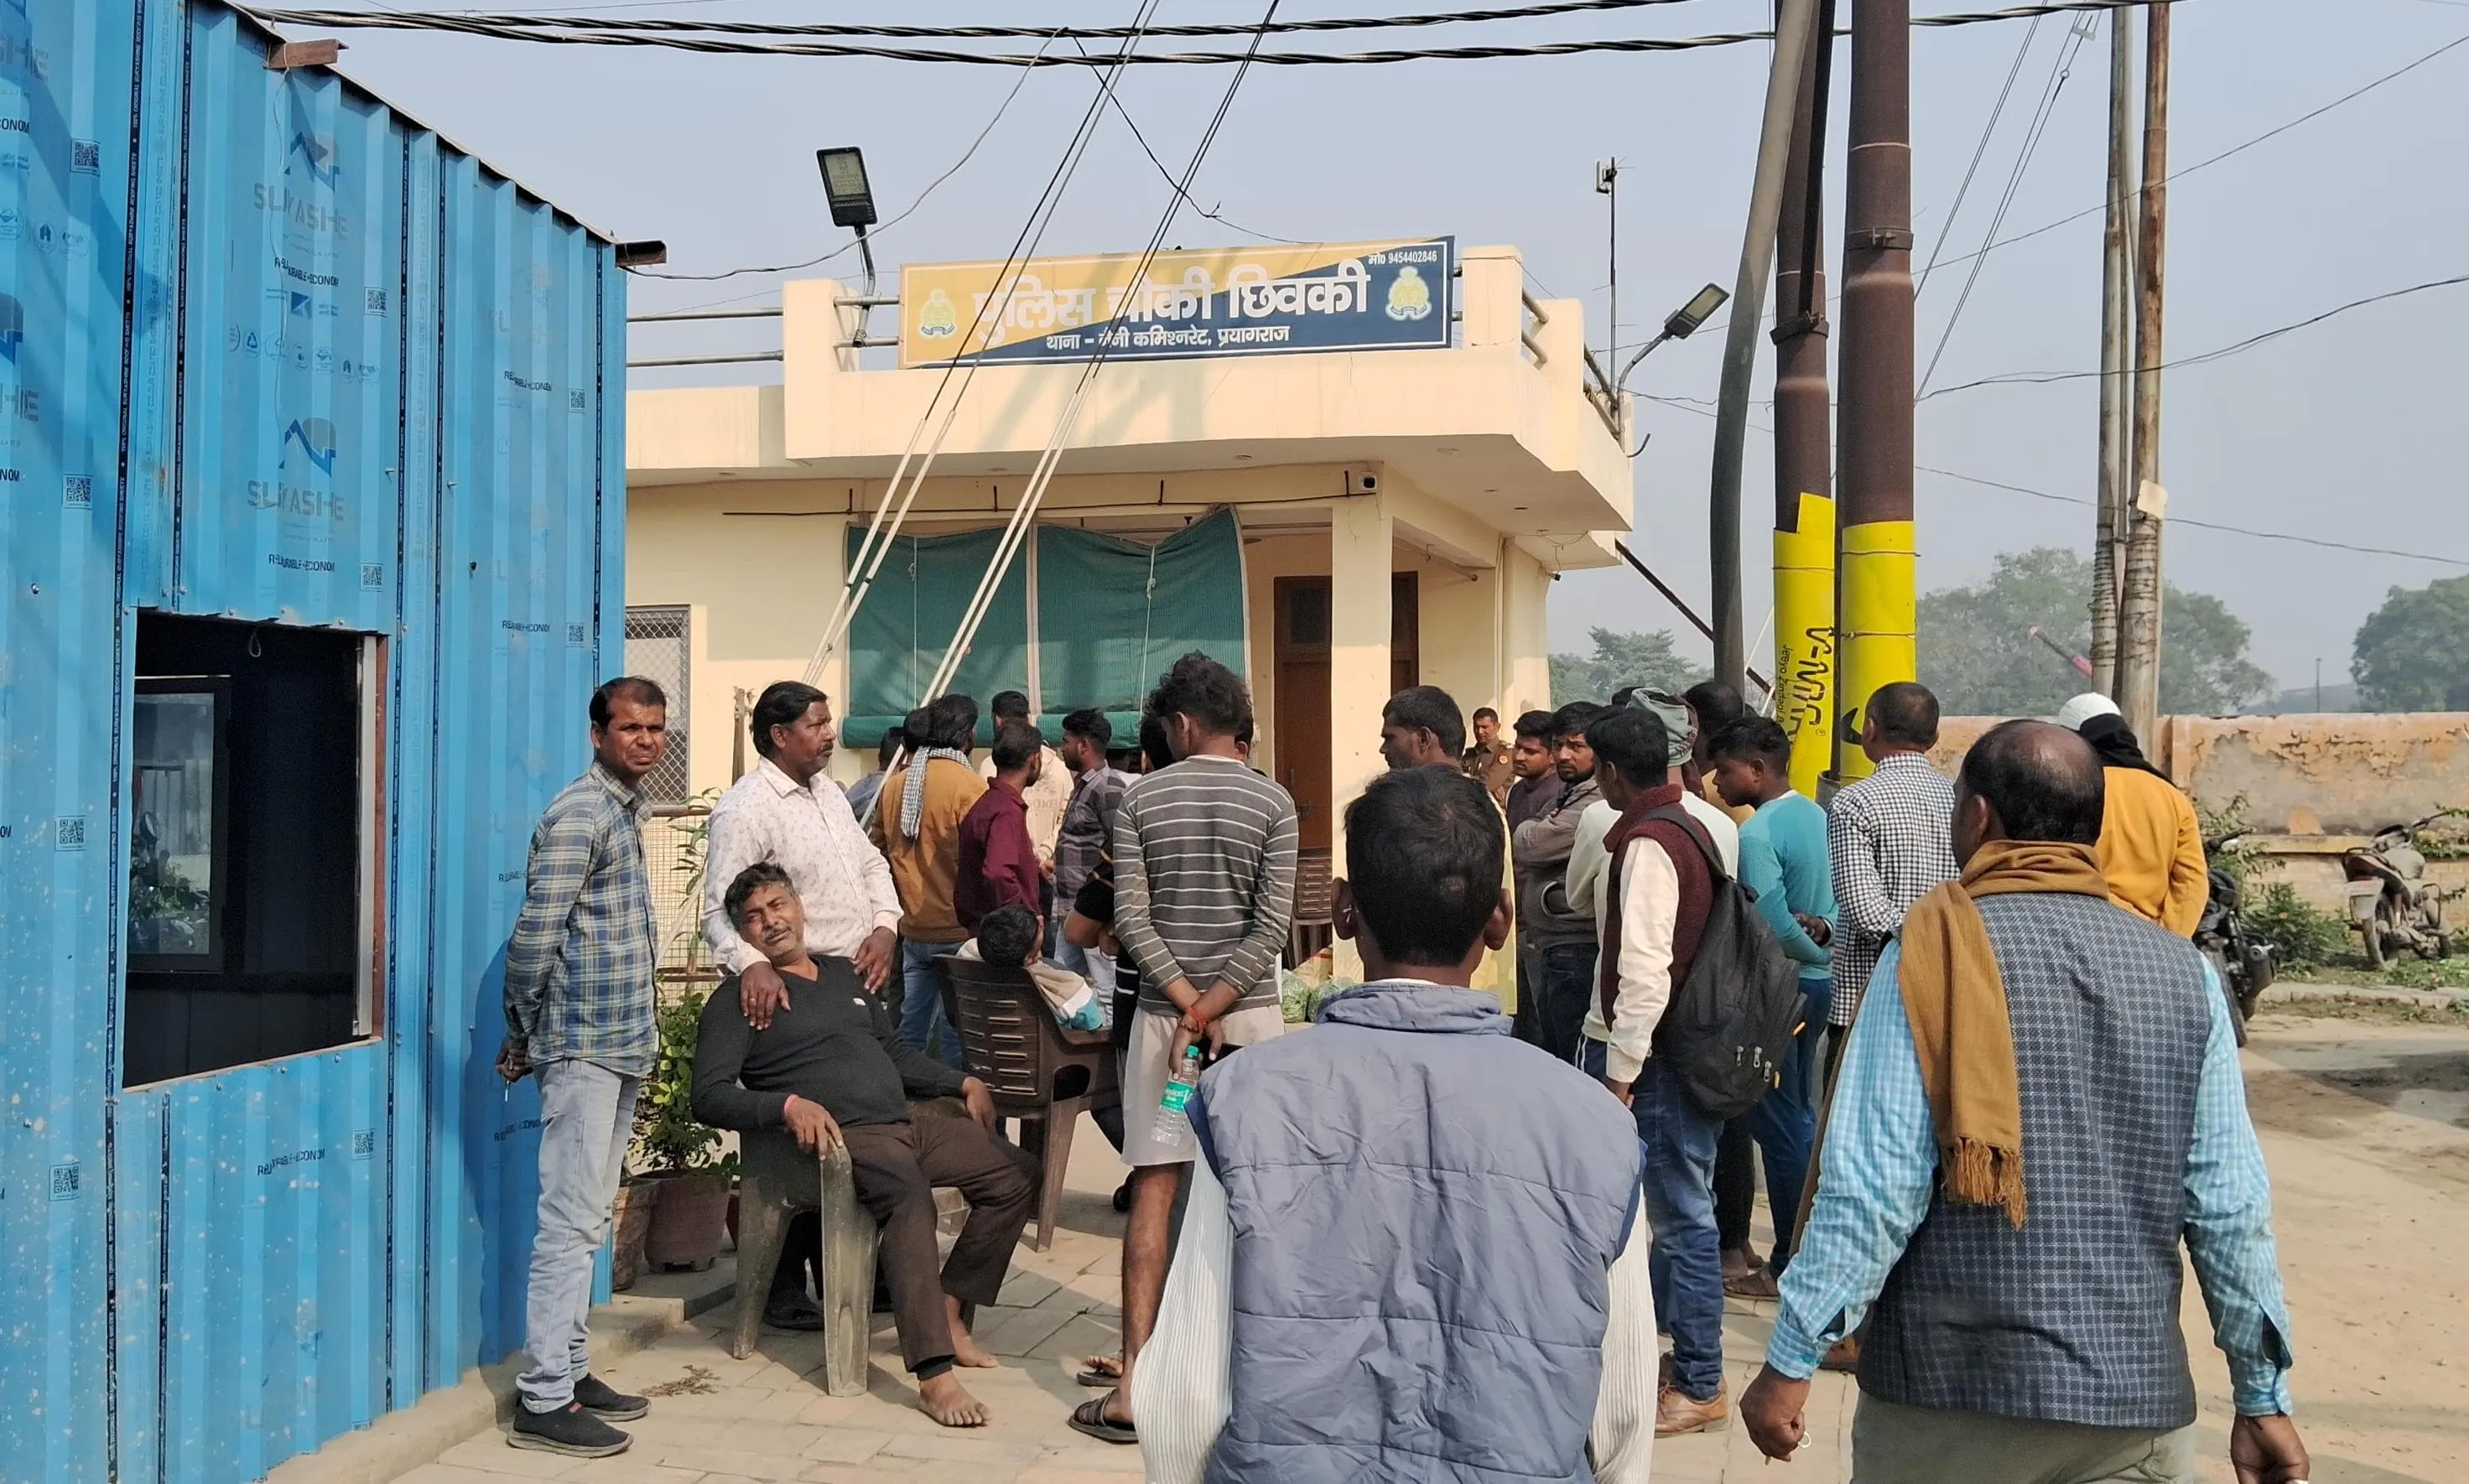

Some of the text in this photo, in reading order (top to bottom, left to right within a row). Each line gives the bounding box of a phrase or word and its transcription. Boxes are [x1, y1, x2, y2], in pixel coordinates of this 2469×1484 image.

[972, 258, 1371, 345] पुलिस चौकी छिवकी
[1046, 335, 1081, 351] थाना
[1218, 325, 1291, 349] प्रयागराज
